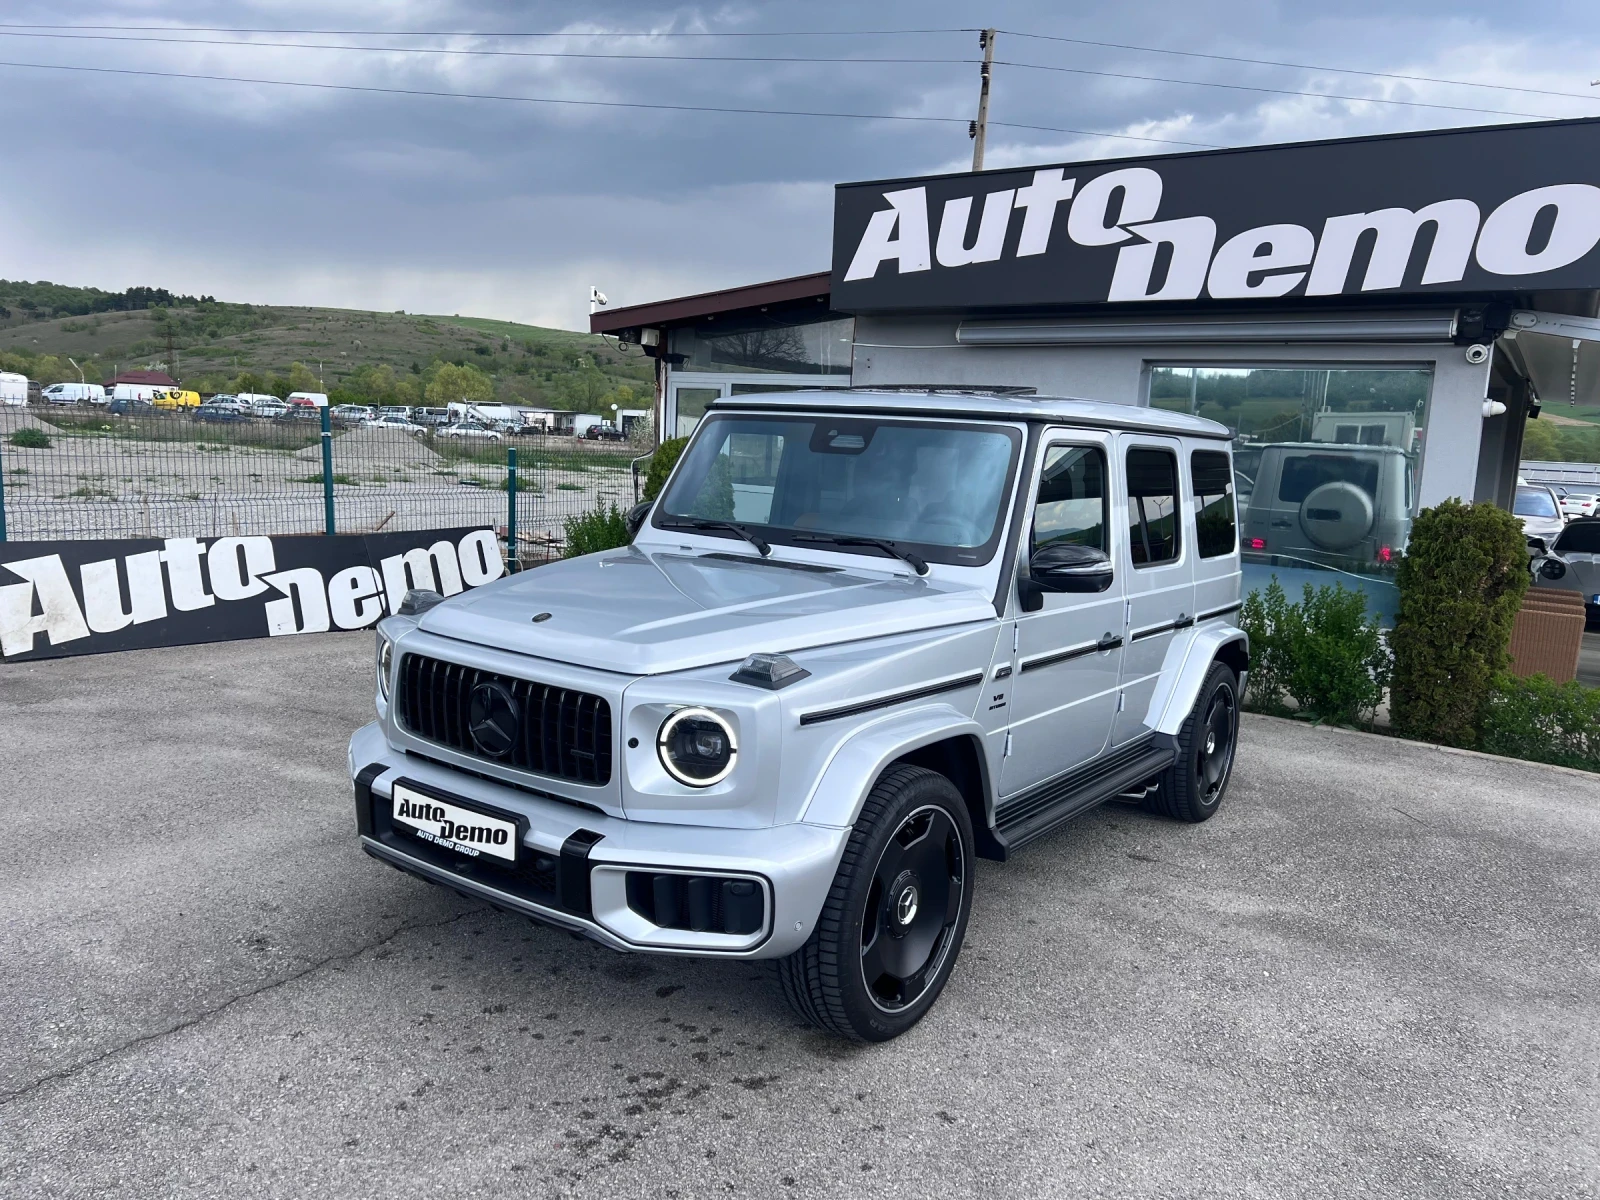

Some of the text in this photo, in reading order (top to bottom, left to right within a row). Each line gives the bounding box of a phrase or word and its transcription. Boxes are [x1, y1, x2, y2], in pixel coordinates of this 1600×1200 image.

[843, 168, 1600, 301] Auto Demo
[0, 529, 505, 656] Auto Demo
[398, 798, 508, 846] Auto Demo
[416, 829, 480, 857] AUTO DEMO GROUP
